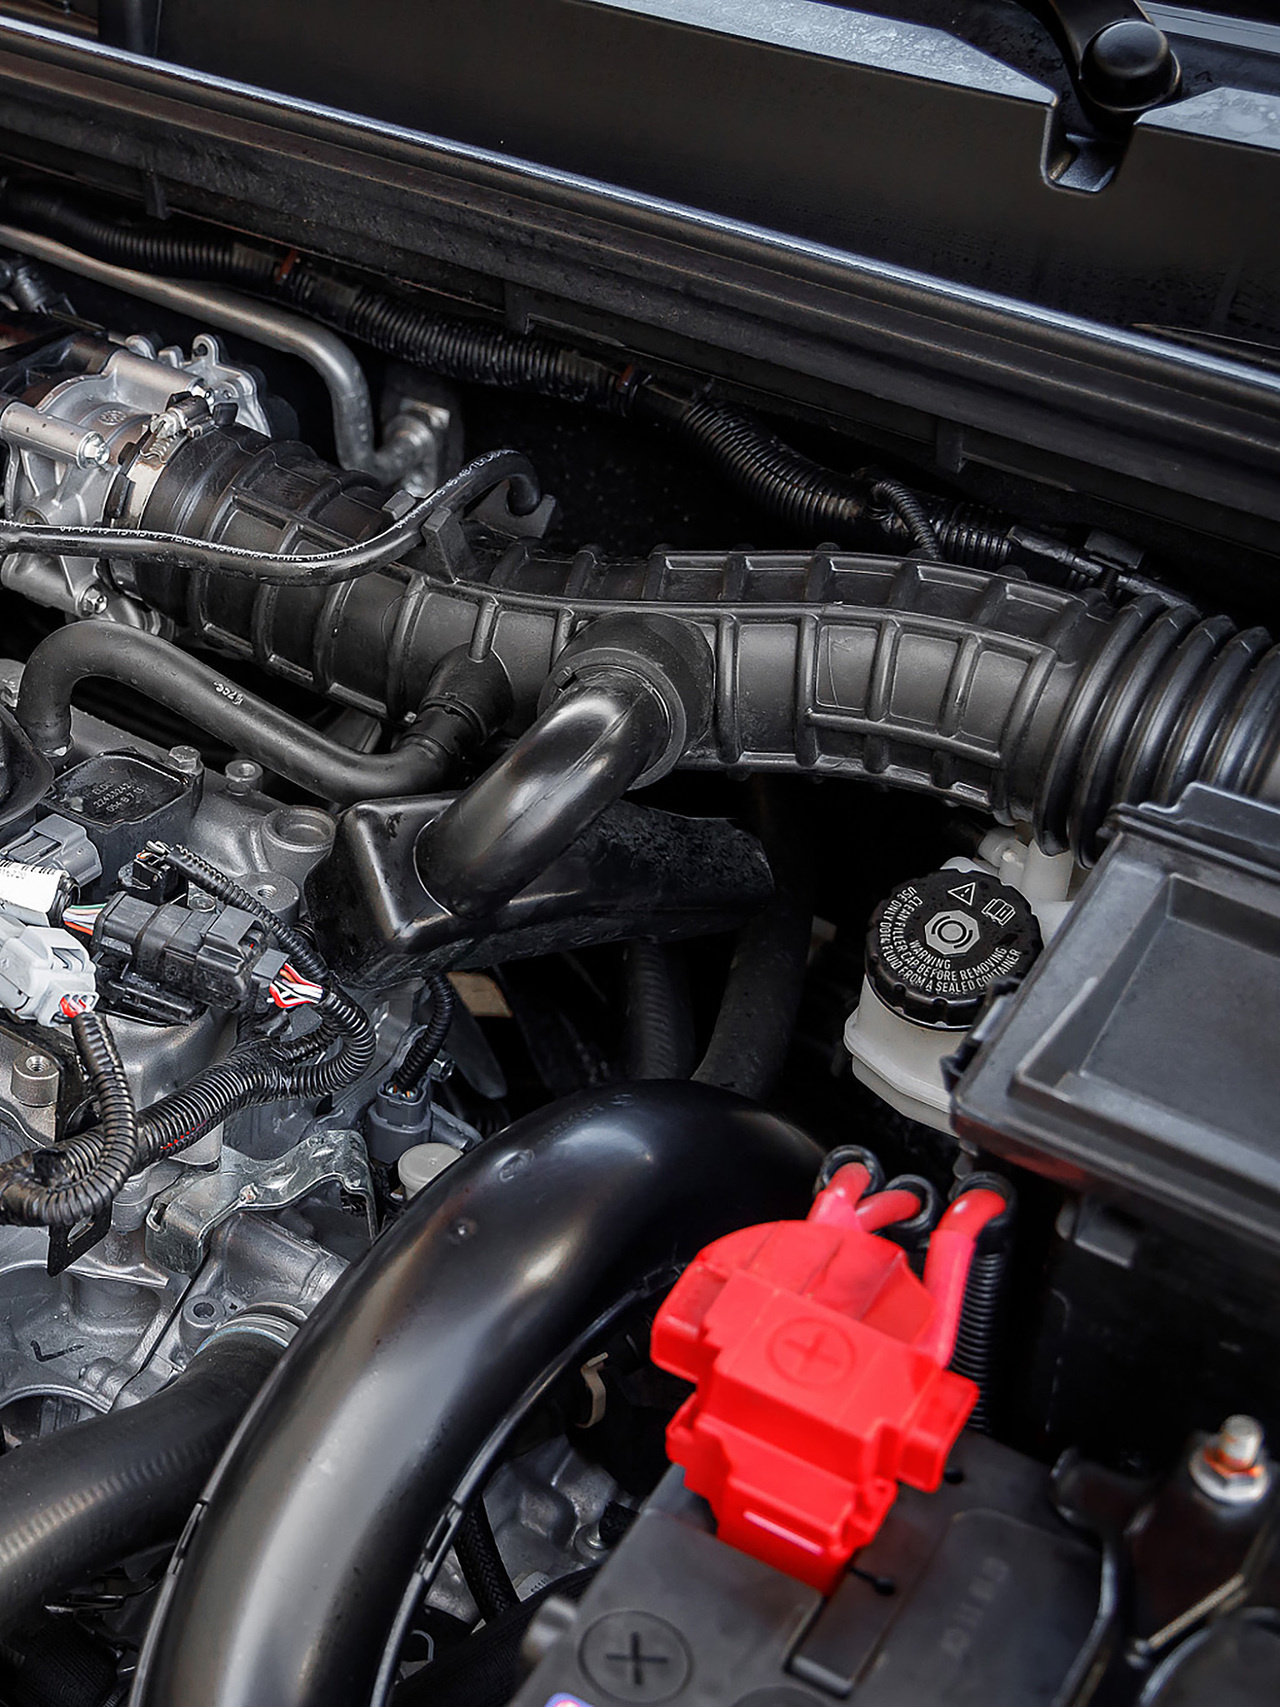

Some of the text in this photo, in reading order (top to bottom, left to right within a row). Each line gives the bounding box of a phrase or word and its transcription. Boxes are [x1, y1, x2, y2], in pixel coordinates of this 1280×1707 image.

[896, 886, 917, 902] USE
[883, 899, 902, 921] ONLY
[892, 896, 1007, 981] CLEAN FILLER CAP BEFORE REMOVING
[881, 944, 903, 970] FLUID
[909, 939, 951, 969] WARNING
[898, 966, 926, 986] FROM
[925, 980, 933, 992] A
[935, 980, 976, 993] SEALED
